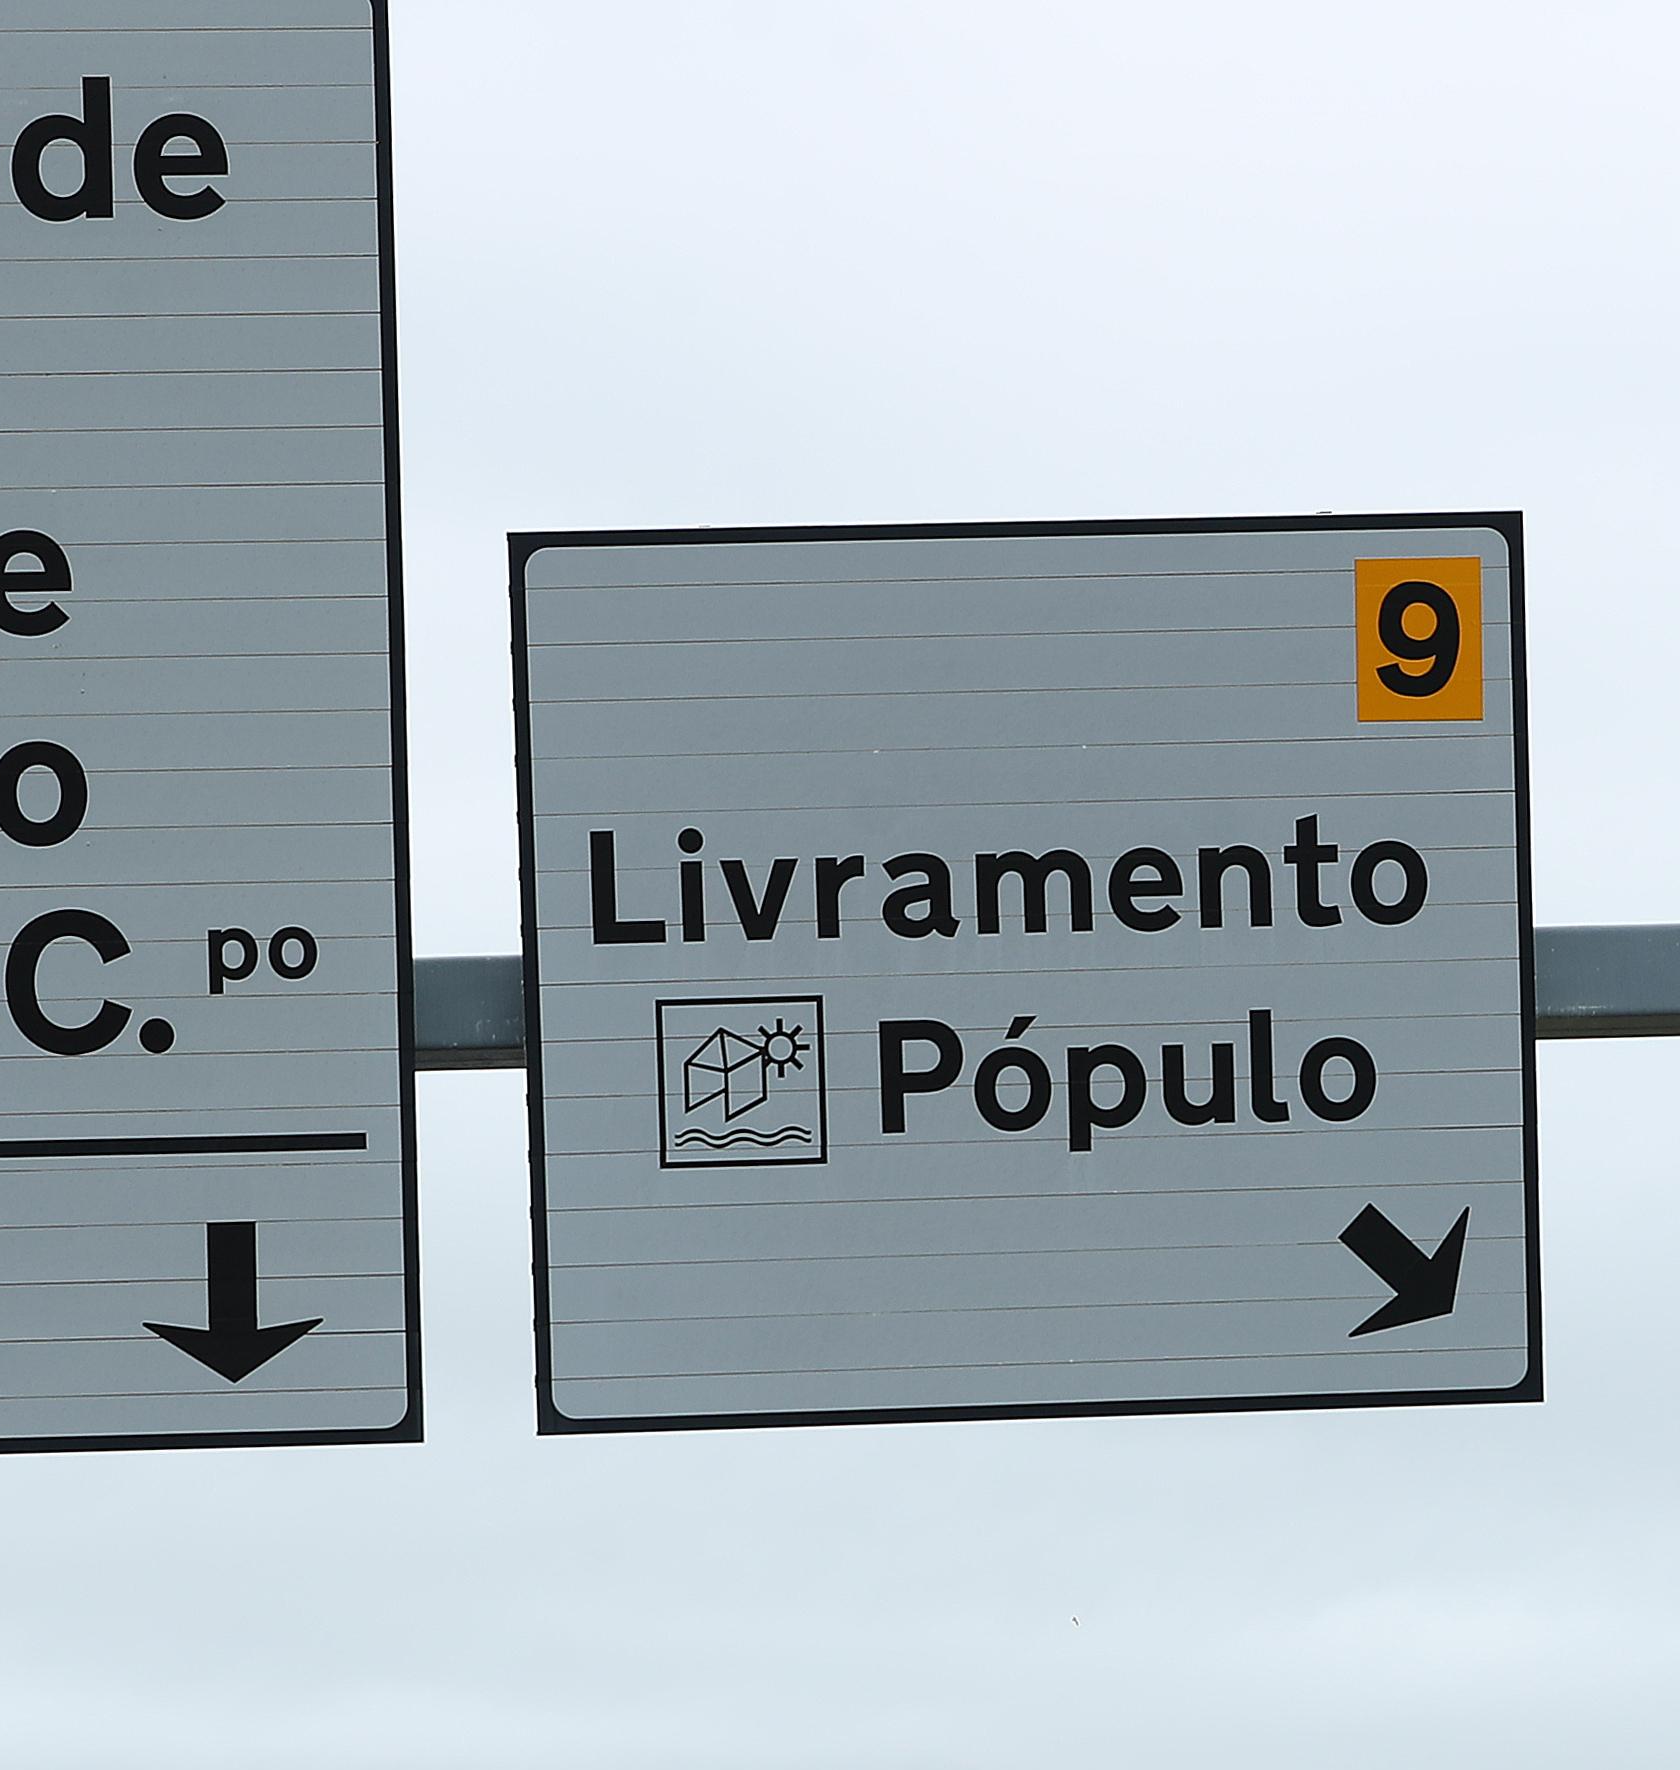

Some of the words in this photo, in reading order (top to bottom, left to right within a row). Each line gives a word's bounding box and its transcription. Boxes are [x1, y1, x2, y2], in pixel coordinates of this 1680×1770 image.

[1376, 581, 1460, 698] 9
[589, 813, 1428, 945] Livramento
[878, 1009, 1377, 1153] Pópulo
